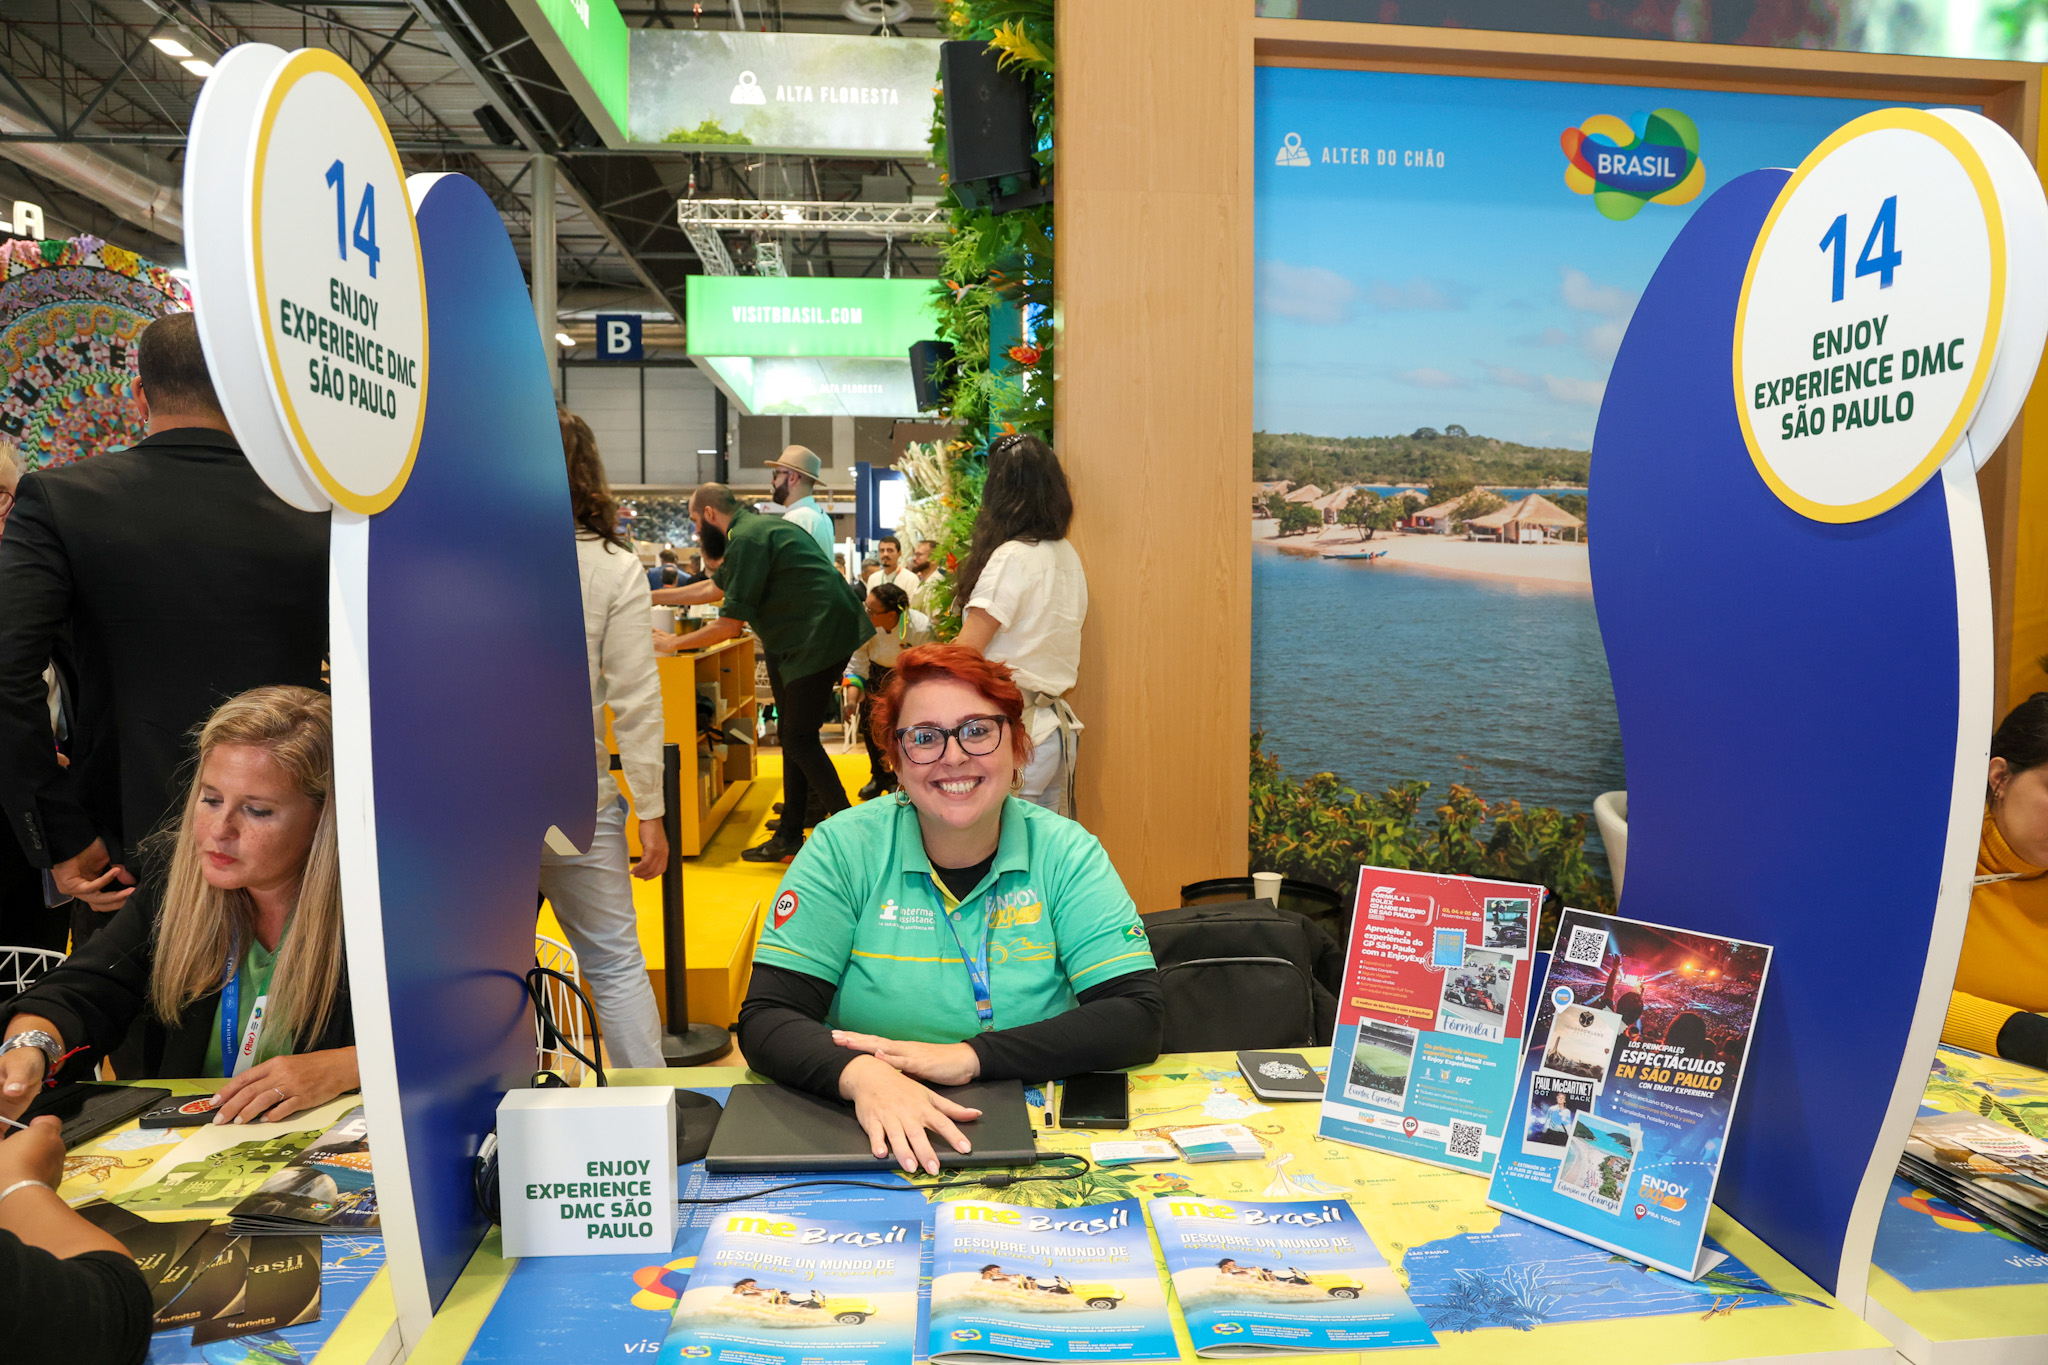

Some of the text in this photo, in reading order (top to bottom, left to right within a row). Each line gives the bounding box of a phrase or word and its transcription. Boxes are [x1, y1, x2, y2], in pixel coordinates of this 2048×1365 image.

[776, 85, 899, 105] ALTA FLORESTA
[1321, 147, 1445, 168] ALTER DO CHÃO
[1598, 153, 1677, 178] BRASIL
[325, 159, 380, 280] 14
[1819, 194, 1902, 303] 14
[330, 277, 378, 330] ENJOY
[732, 305, 863, 325] VISITBRASIL.COM
[281, 299, 416, 389] EXPERIENCE DMC
[606, 320, 632, 354] B
[1813, 314, 1889, 361] ENJOY
[1754, 338, 1964, 410] EXPERIENCE DMC
[309, 356, 396, 420] SÃO PAULO
[1781, 390, 1914, 440] SÃO PAULO
[778, 900, 793, 911] SP
[985, 887, 1038, 912] ENJOY
[1370, 898, 1394, 906] ROLEX
[1364, 933, 1424, 947] experiência do
[1365, 924, 1405, 936] Aproveite
[1362, 939, 1416, 954] GP São Paulo
[1361, 949, 1380, 957] com
[1387, 951, 1427, 965] EnjoyExp
[1443, 1015, 1497, 1040] Fórmula 1
[1628, 1040, 1686, 1055] LOS PRINCIPALES
[1427, 1056, 1444, 1065] Enjoy
[1445, 1058, 1480, 1071] Experience.
[1464, 1056, 1482, 1065] Brasil
[1619, 1048, 1726, 1076] ESPECTÁCULOS
[1455, 1076, 1473, 1085] UFC
[1535, 1076, 1593, 1096] PAUL McCARTNEY
[1614, 1064, 1723, 1092] EN SÃO PAULO
[1348, 1086, 1369, 1100] Eventos
[1570, 1094, 1590, 1102] BACK
[1638, 1081, 1715, 1099] CON ENJOY EXPERIENCE
[1660, 1101, 1675, 1111] Enjoy
[1675, 1105, 1704, 1118] Experience
[587, 1160, 651, 1177] ENJOY
[526, 1181, 652, 1200] EXPERIENCE
[1641, 1174, 1689, 1198] ENJOY
[561, 1198, 652, 1219] DMC SÃO
[1243, 1205, 1343, 1228] Brasil
[1646, 1210, 1660, 1219] PRA
[1660, 1213, 1681, 1226] TODOS
[588, 1222, 653, 1239] PAULO
[1028, 1207, 1129, 1236] Brasil
[800, 1225, 908, 1248] Brasil
[1180, 1233, 1352, 1249] DESCUBRE UN MUNDO DE
[953, 1237, 1129, 1257] DESCUBRE UN MUNDO DE
[716, 1250, 896, 1270] DESCUBRE UN MUNDO DE
